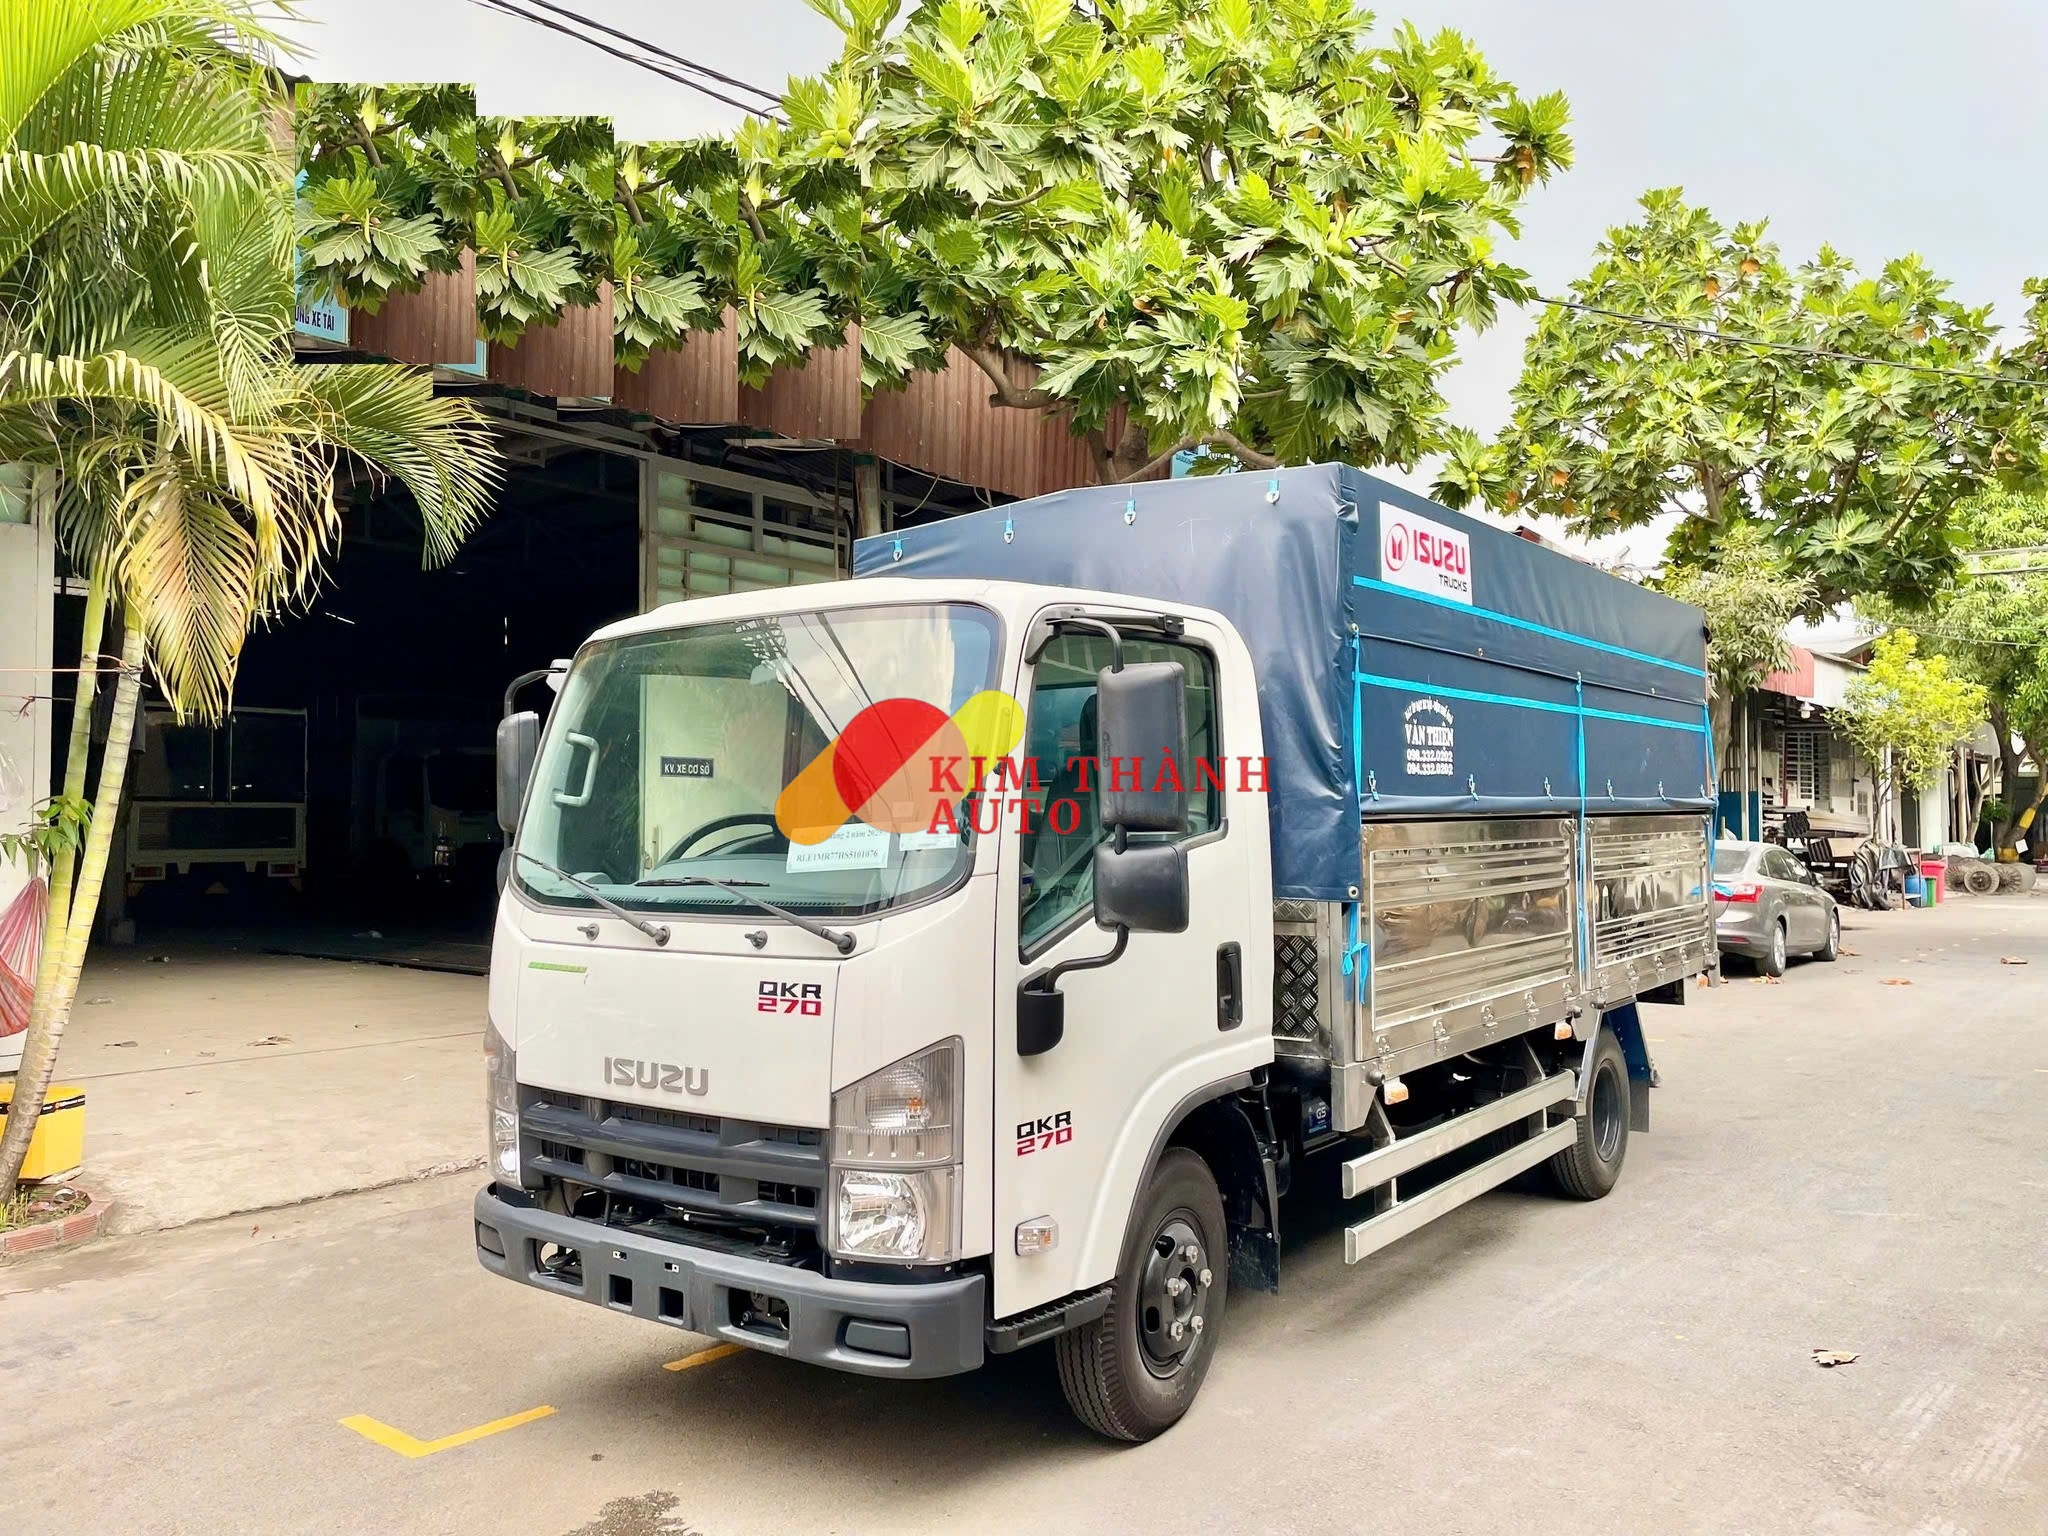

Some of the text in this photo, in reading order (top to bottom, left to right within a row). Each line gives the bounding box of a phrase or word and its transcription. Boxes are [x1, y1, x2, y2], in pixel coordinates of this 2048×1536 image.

[312, 310, 321, 327] XE
[323, 309, 335, 331] TẢI
[1414, 529, 1466, 575] ISUZU
[1439, 573, 1468, 592] TRUCKS
[677, 764, 686, 773] XE
[758, 981, 822, 999] QKR
[758, 997, 822, 1016] 270
[604, 1056, 709, 1096] ISUZU
[1017, 1111, 1071, 1140] QKR
[1017, 1127, 1072, 1156] 270
